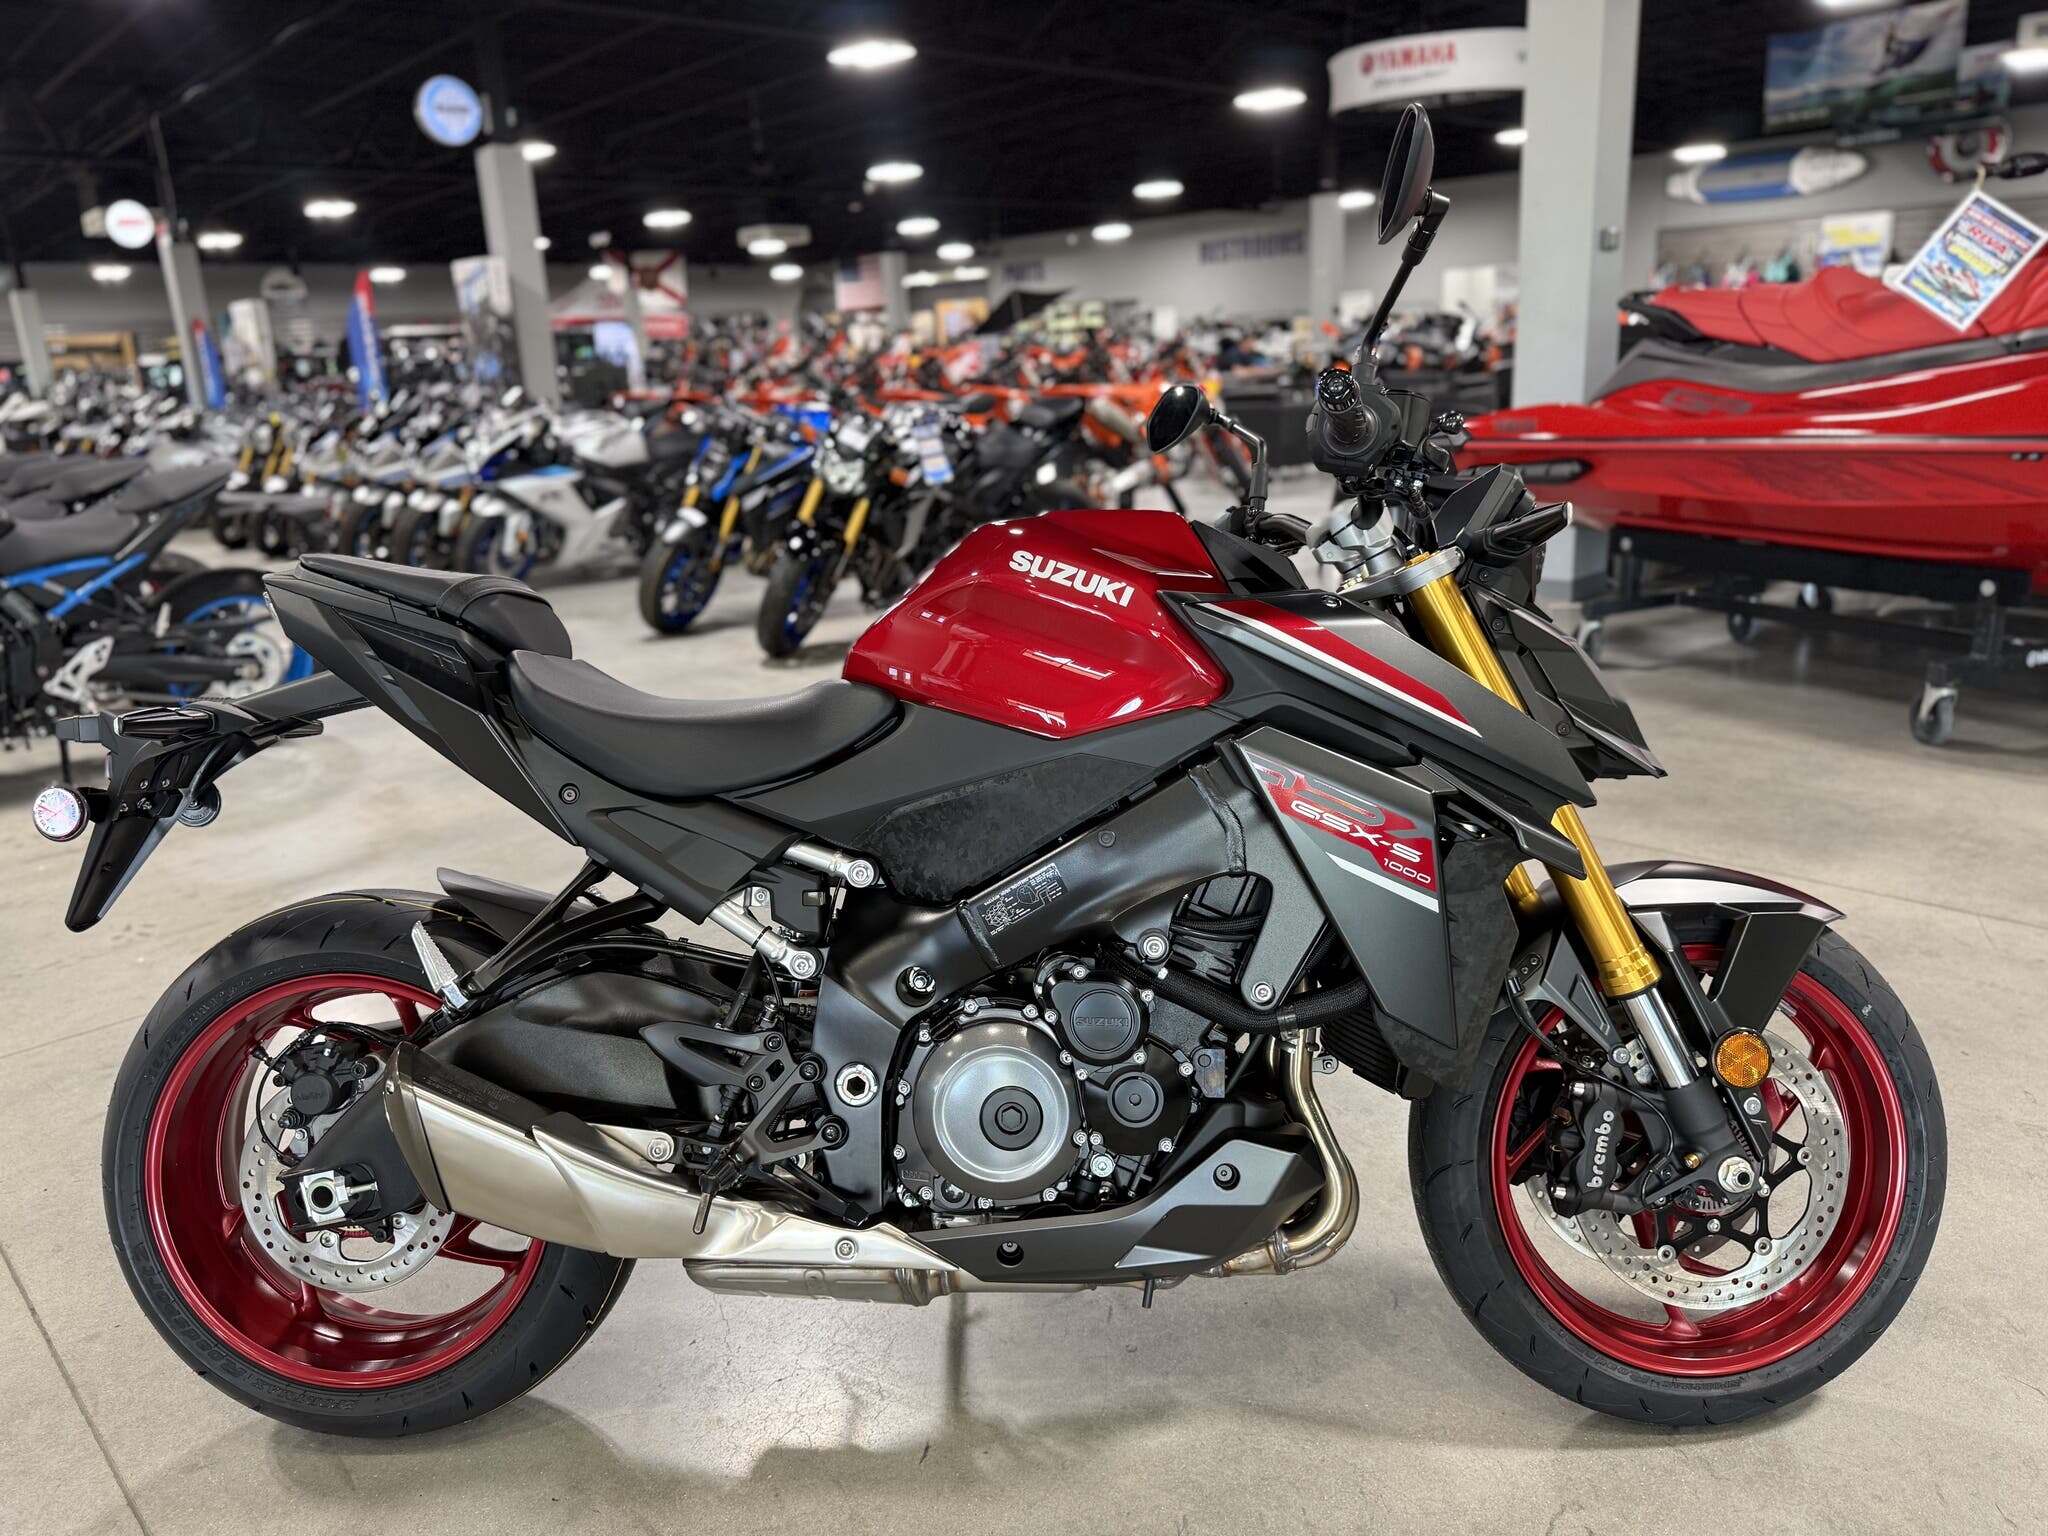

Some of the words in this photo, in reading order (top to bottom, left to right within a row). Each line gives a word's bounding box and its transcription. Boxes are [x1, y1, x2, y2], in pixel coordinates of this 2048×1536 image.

[1009, 550, 1135, 608] SUZUKI
[1291, 800, 1423, 863] GSX-S
[1383, 857, 1431, 884] 1000
[1075, 1016, 1129, 1028] SUZUKI
[1586, 1110, 1615, 1188] brembo
